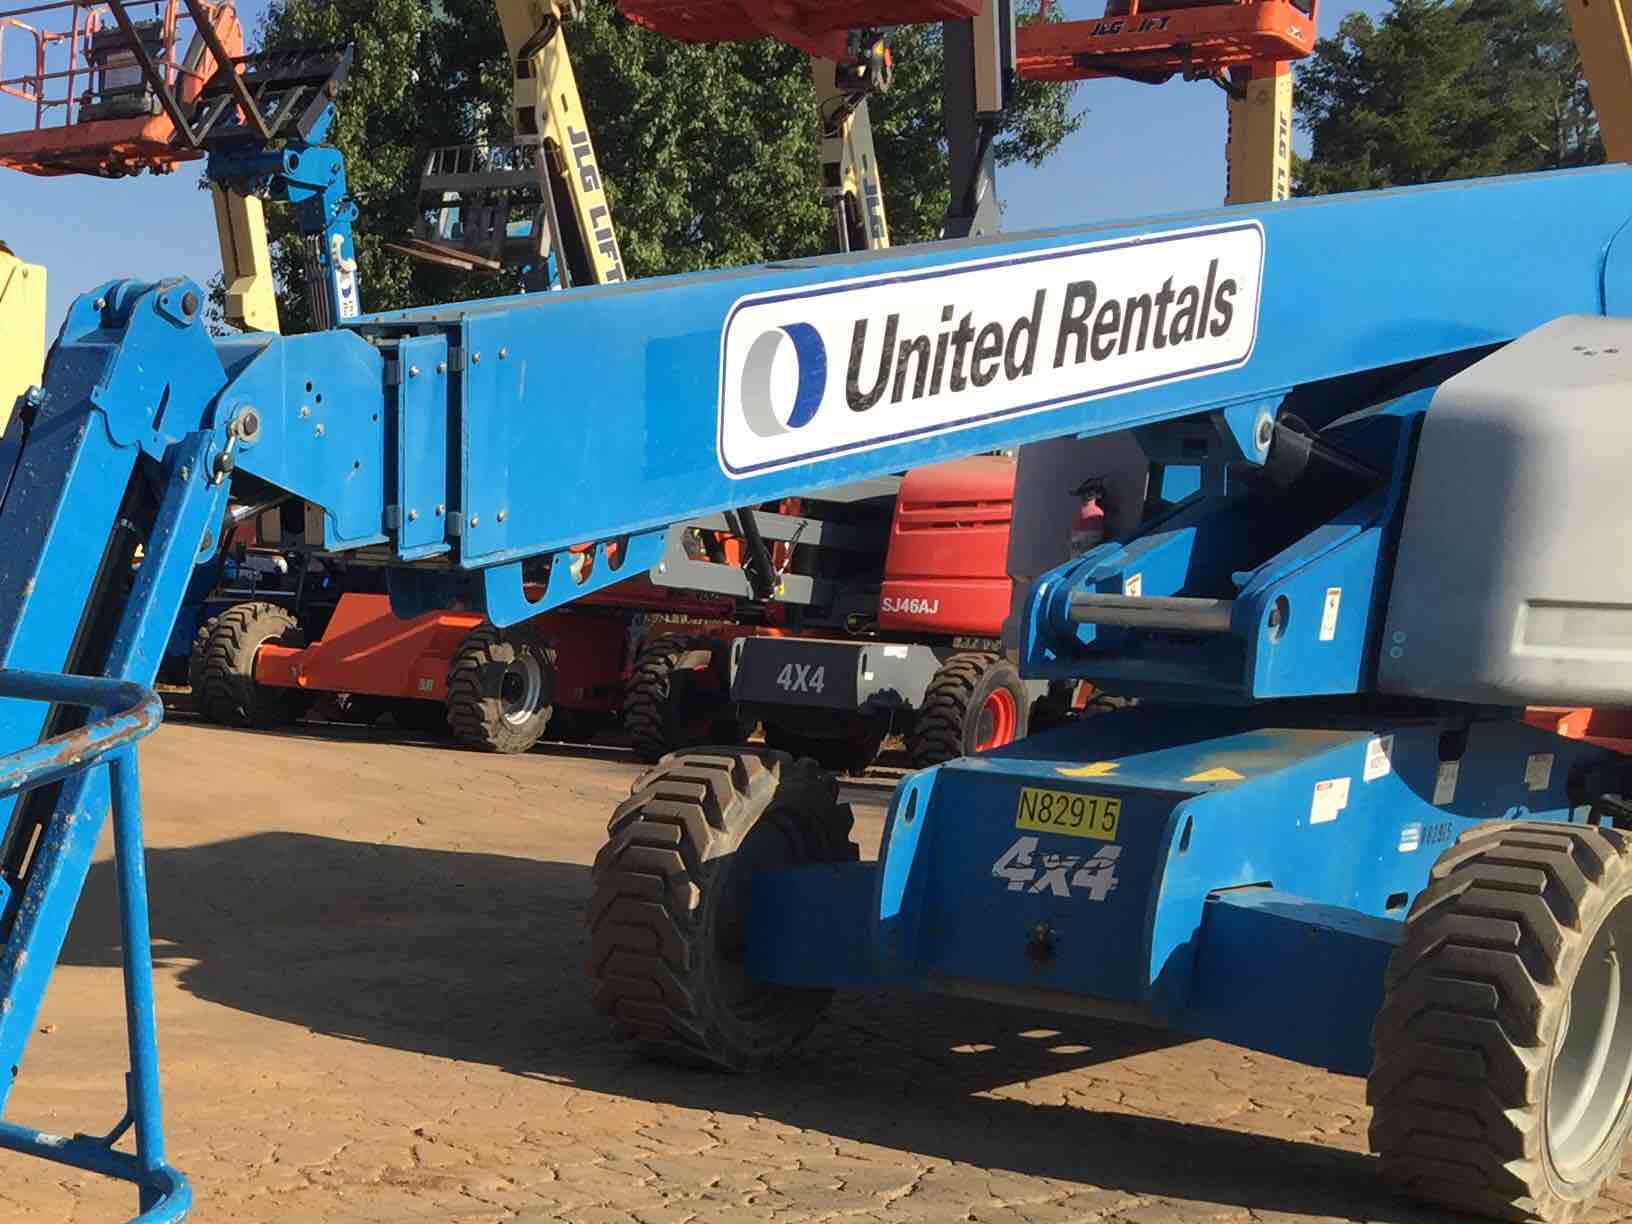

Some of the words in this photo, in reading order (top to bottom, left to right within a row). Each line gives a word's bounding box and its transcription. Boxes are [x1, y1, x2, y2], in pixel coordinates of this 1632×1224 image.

[567, 126, 600, 192] JLG
[589, 205, 625, 282] LIFT
[845, 289, 1047, 413] United
[1053, 259, 1238, 370] Rentals
[881, 597, 939, 614] SJ46AJ
[776, 663, 825, 693] 4X4
[1018, 791, 1118, 832] N82915
[992, 846, 1123, 901] 4x4
